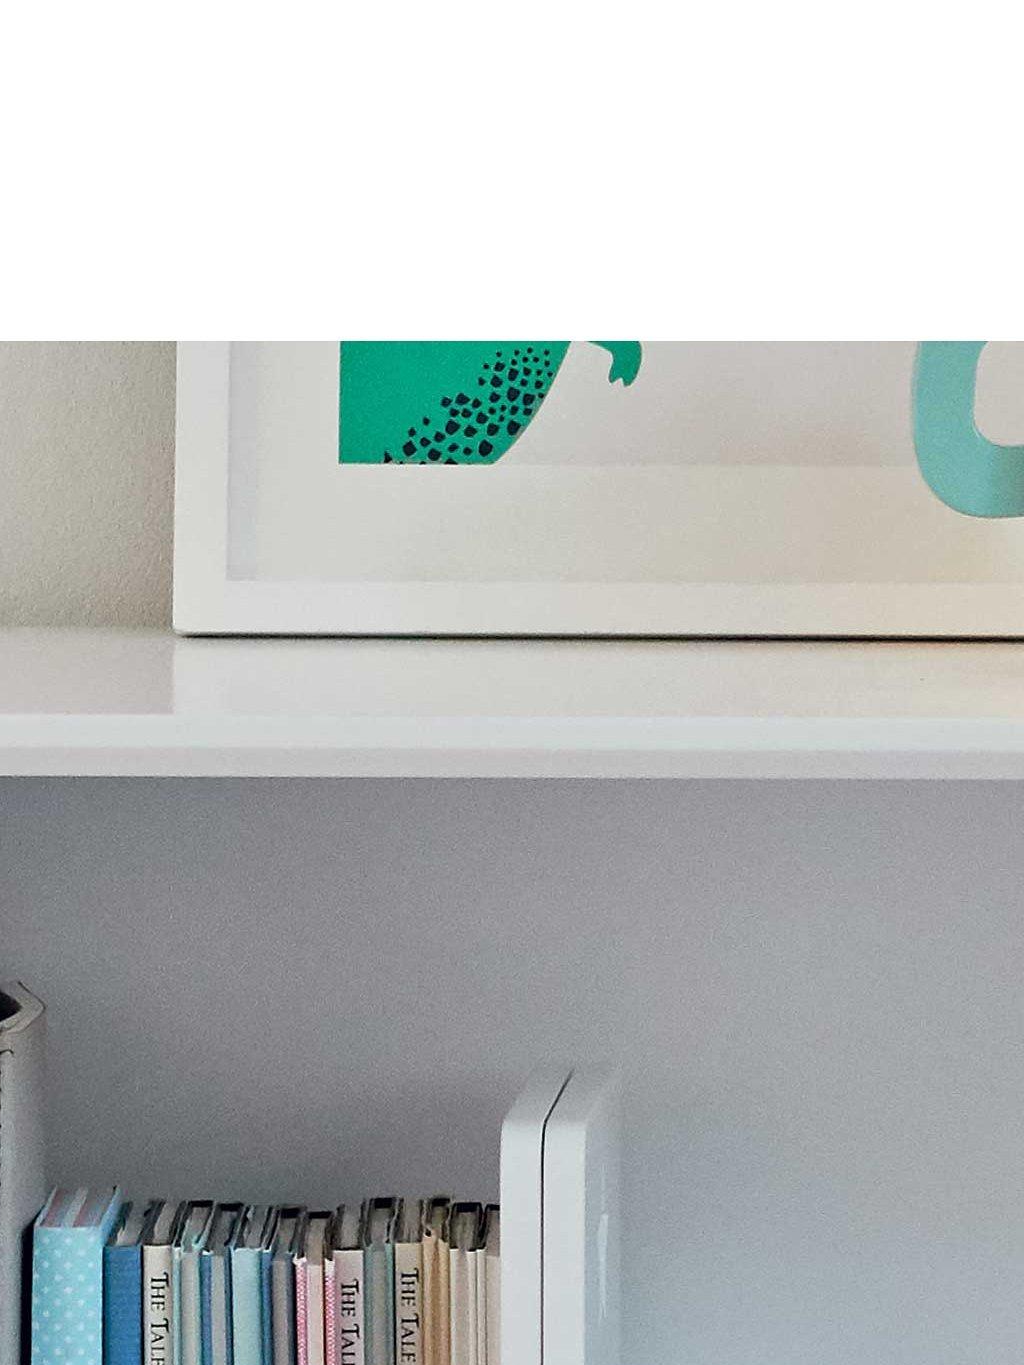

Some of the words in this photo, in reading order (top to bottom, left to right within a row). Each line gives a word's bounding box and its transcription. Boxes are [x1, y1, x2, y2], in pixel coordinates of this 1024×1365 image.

[150, 1272, 169, 1311] THE
[341, 1279, 360, 1317] THE
[401, 1268, 420, 1306] THE
[401, 1313, 420, 1362] TALE
